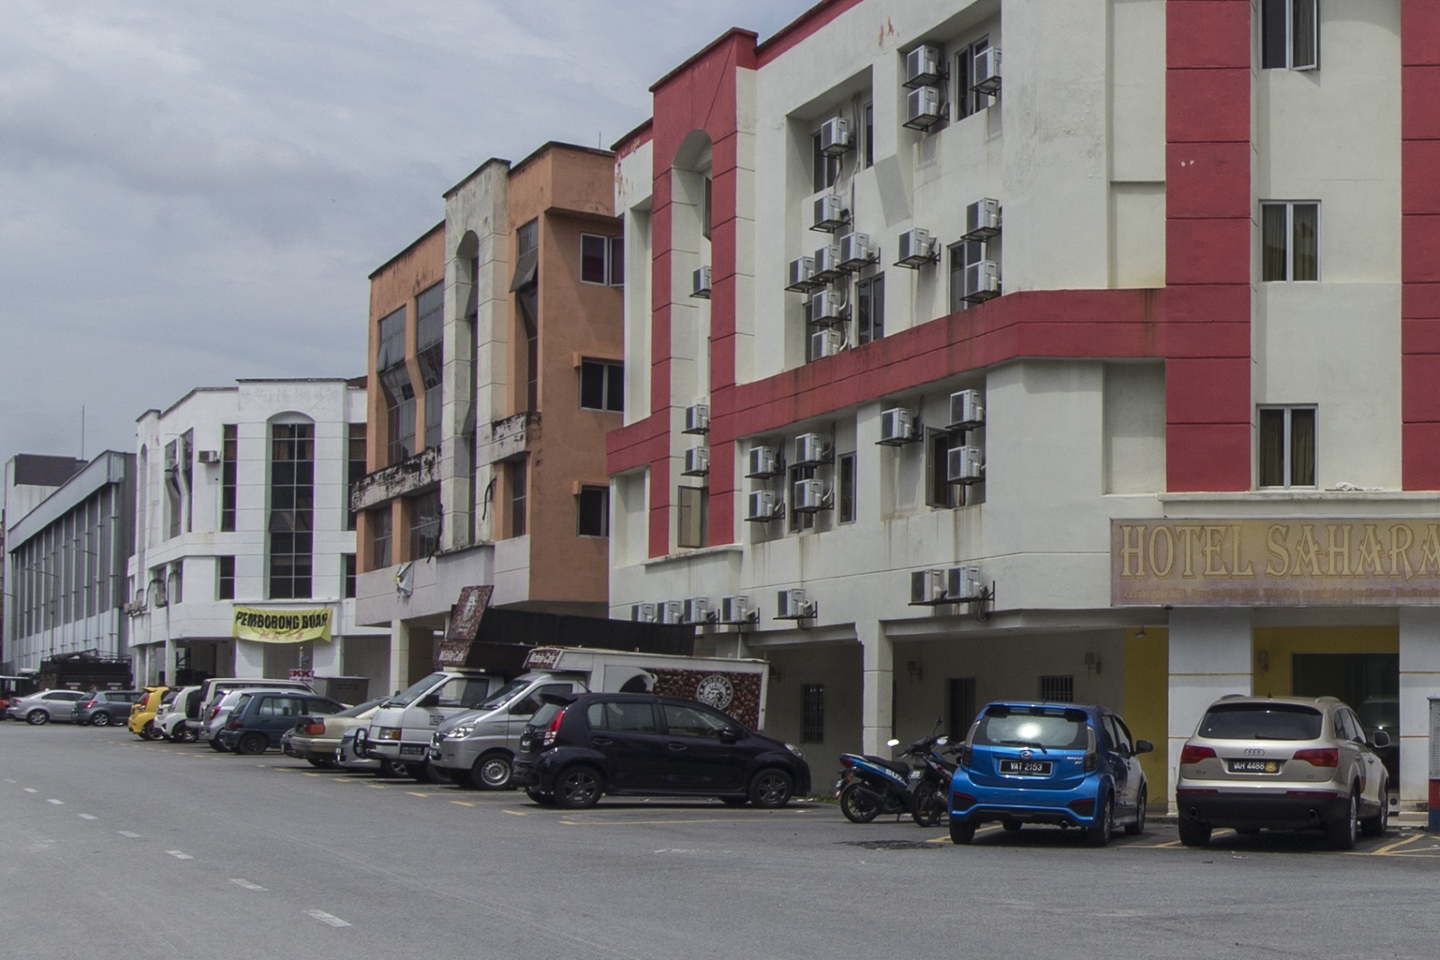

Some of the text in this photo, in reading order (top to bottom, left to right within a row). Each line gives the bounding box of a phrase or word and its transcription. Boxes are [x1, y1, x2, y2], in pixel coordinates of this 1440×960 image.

[1119, 524, 1255, 579] HOTEL
[236, 611, 300, 629] PEMBORONG
[1024, 763, 1042, 771] 2153
[1246, 762, 1264, 770] 4488
